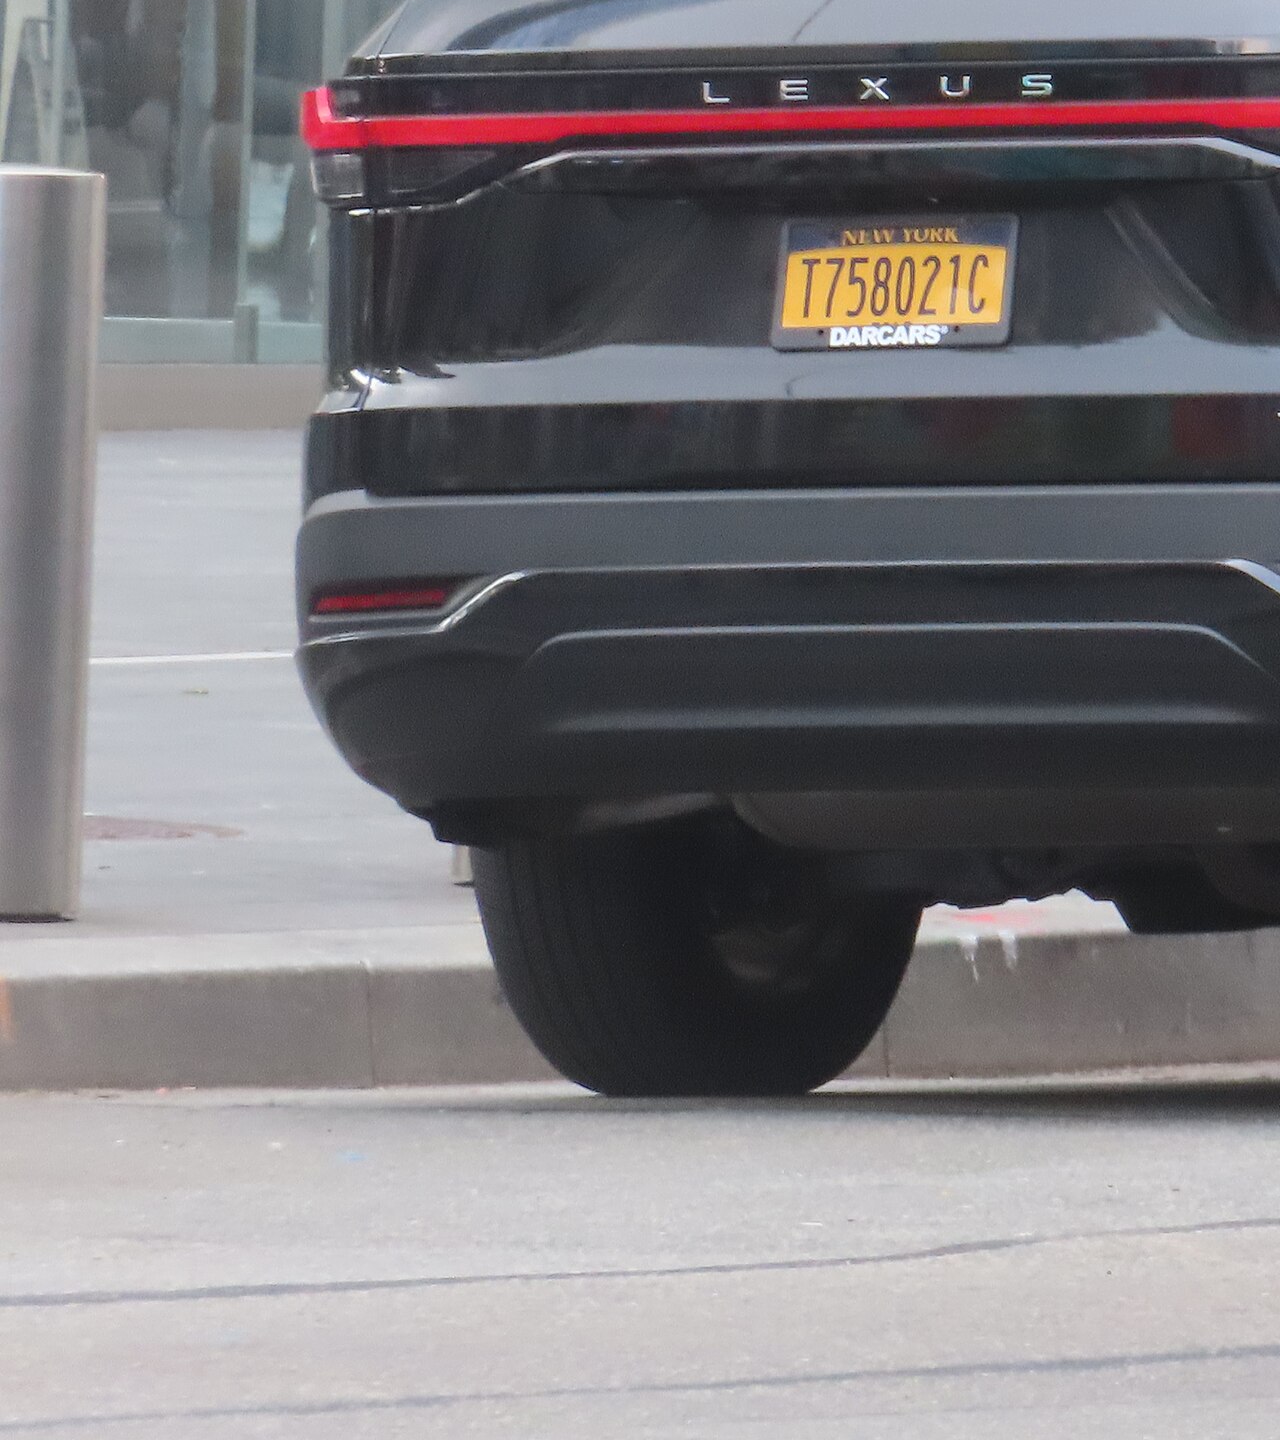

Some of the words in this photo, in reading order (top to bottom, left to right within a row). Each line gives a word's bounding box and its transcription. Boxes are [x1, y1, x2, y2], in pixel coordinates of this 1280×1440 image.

[703, 73, 1053, 104] LEXUS
[839, 228, 896, 247] NEW
[903, 226, 962, 244] YORK
[802, 254, 989, 318] T758021C
